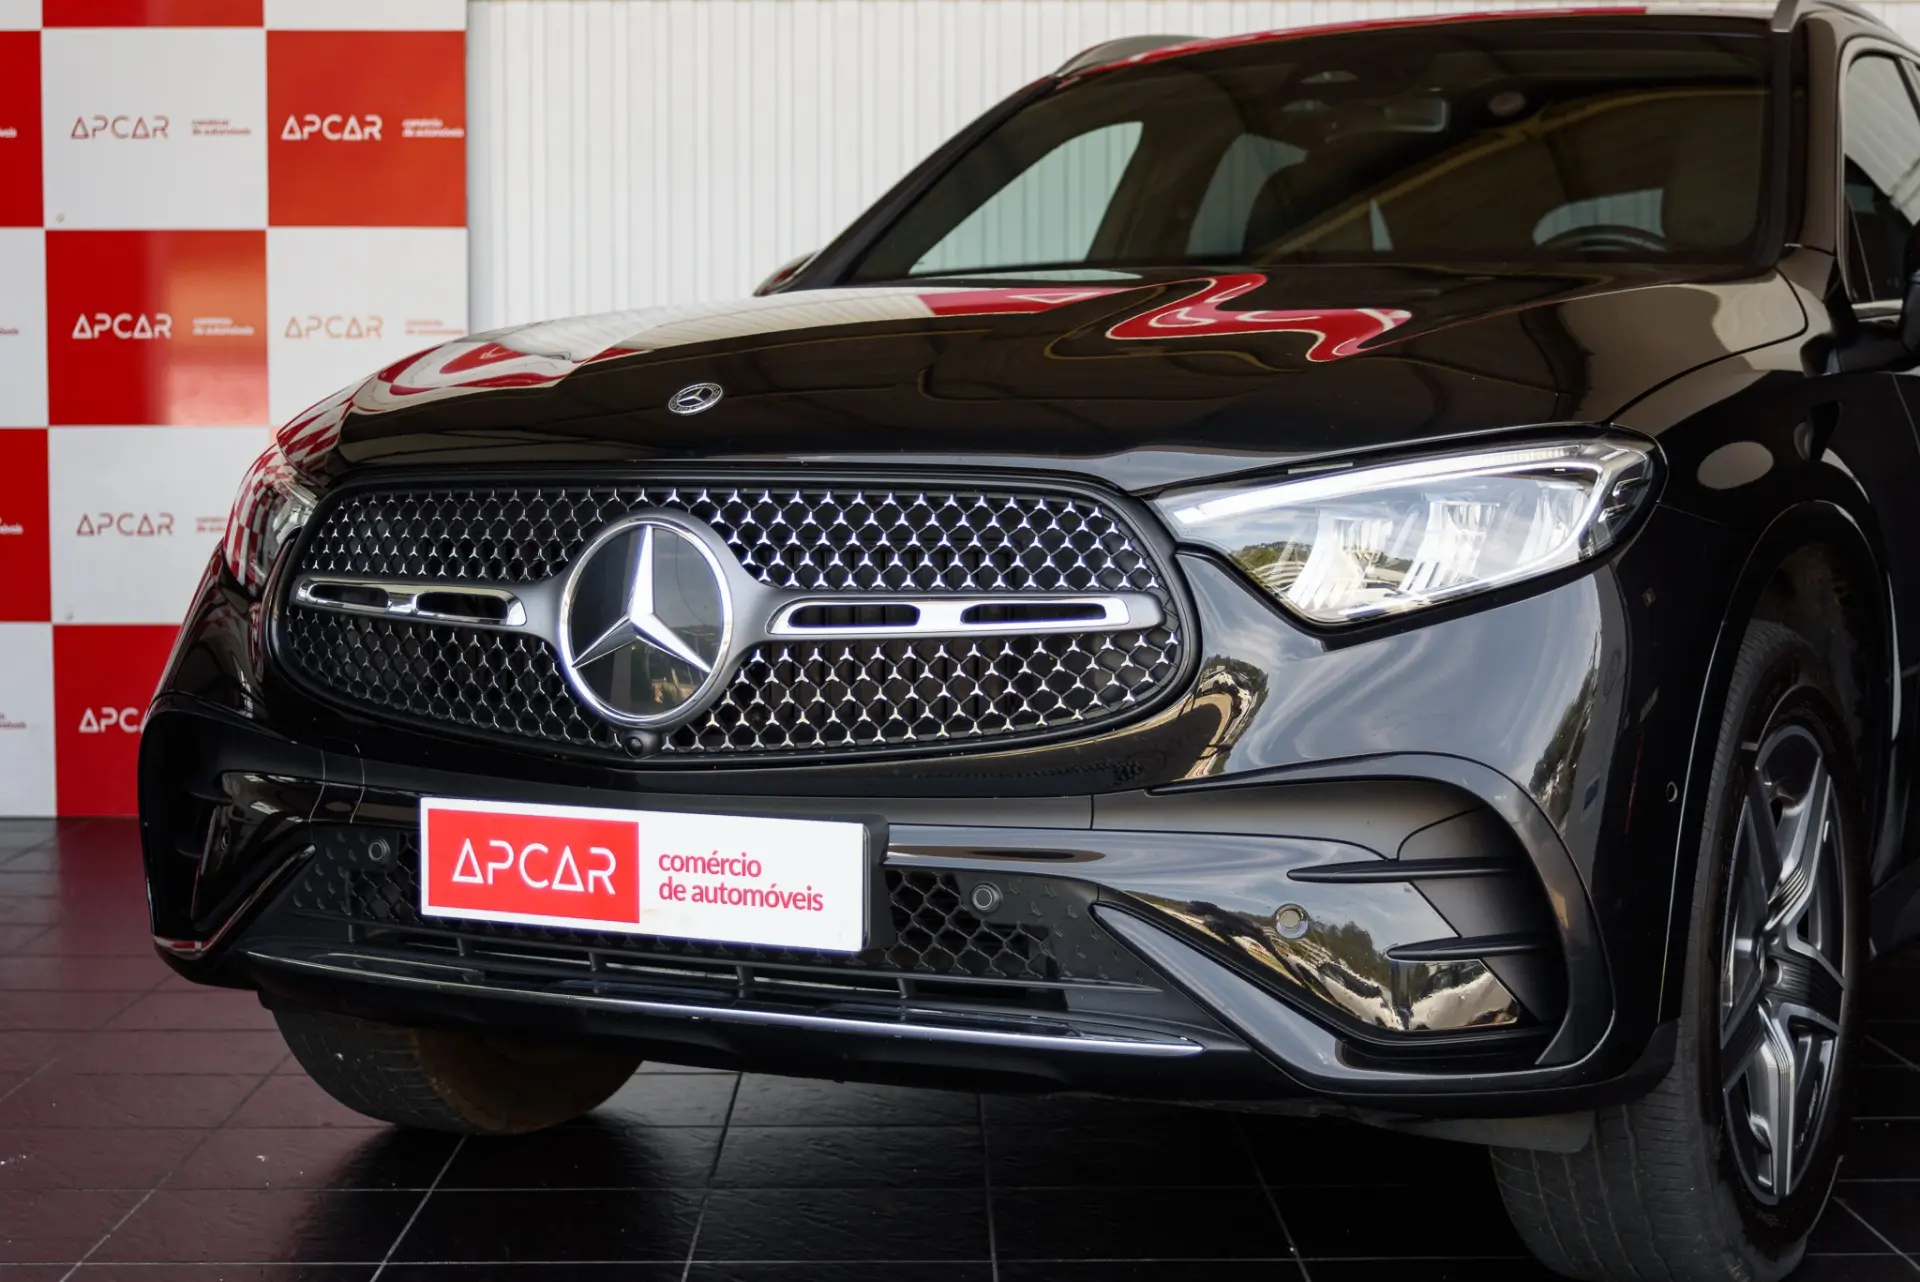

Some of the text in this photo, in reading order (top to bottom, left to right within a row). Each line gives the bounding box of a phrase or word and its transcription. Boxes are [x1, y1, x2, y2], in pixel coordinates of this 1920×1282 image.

[71, 115, 170, 140] APCAR
[281, 114, 383, 141] APCAR
[72, 313, 172, 340] APCAR
[284, 315, 384, 340] APCAR
[76, 512, 175, 537] APCAR
[451, 838, 617, 896] APCAR
[658, 849, 763, 878] comércio
[658, 876, 824, 912] de automóveis
